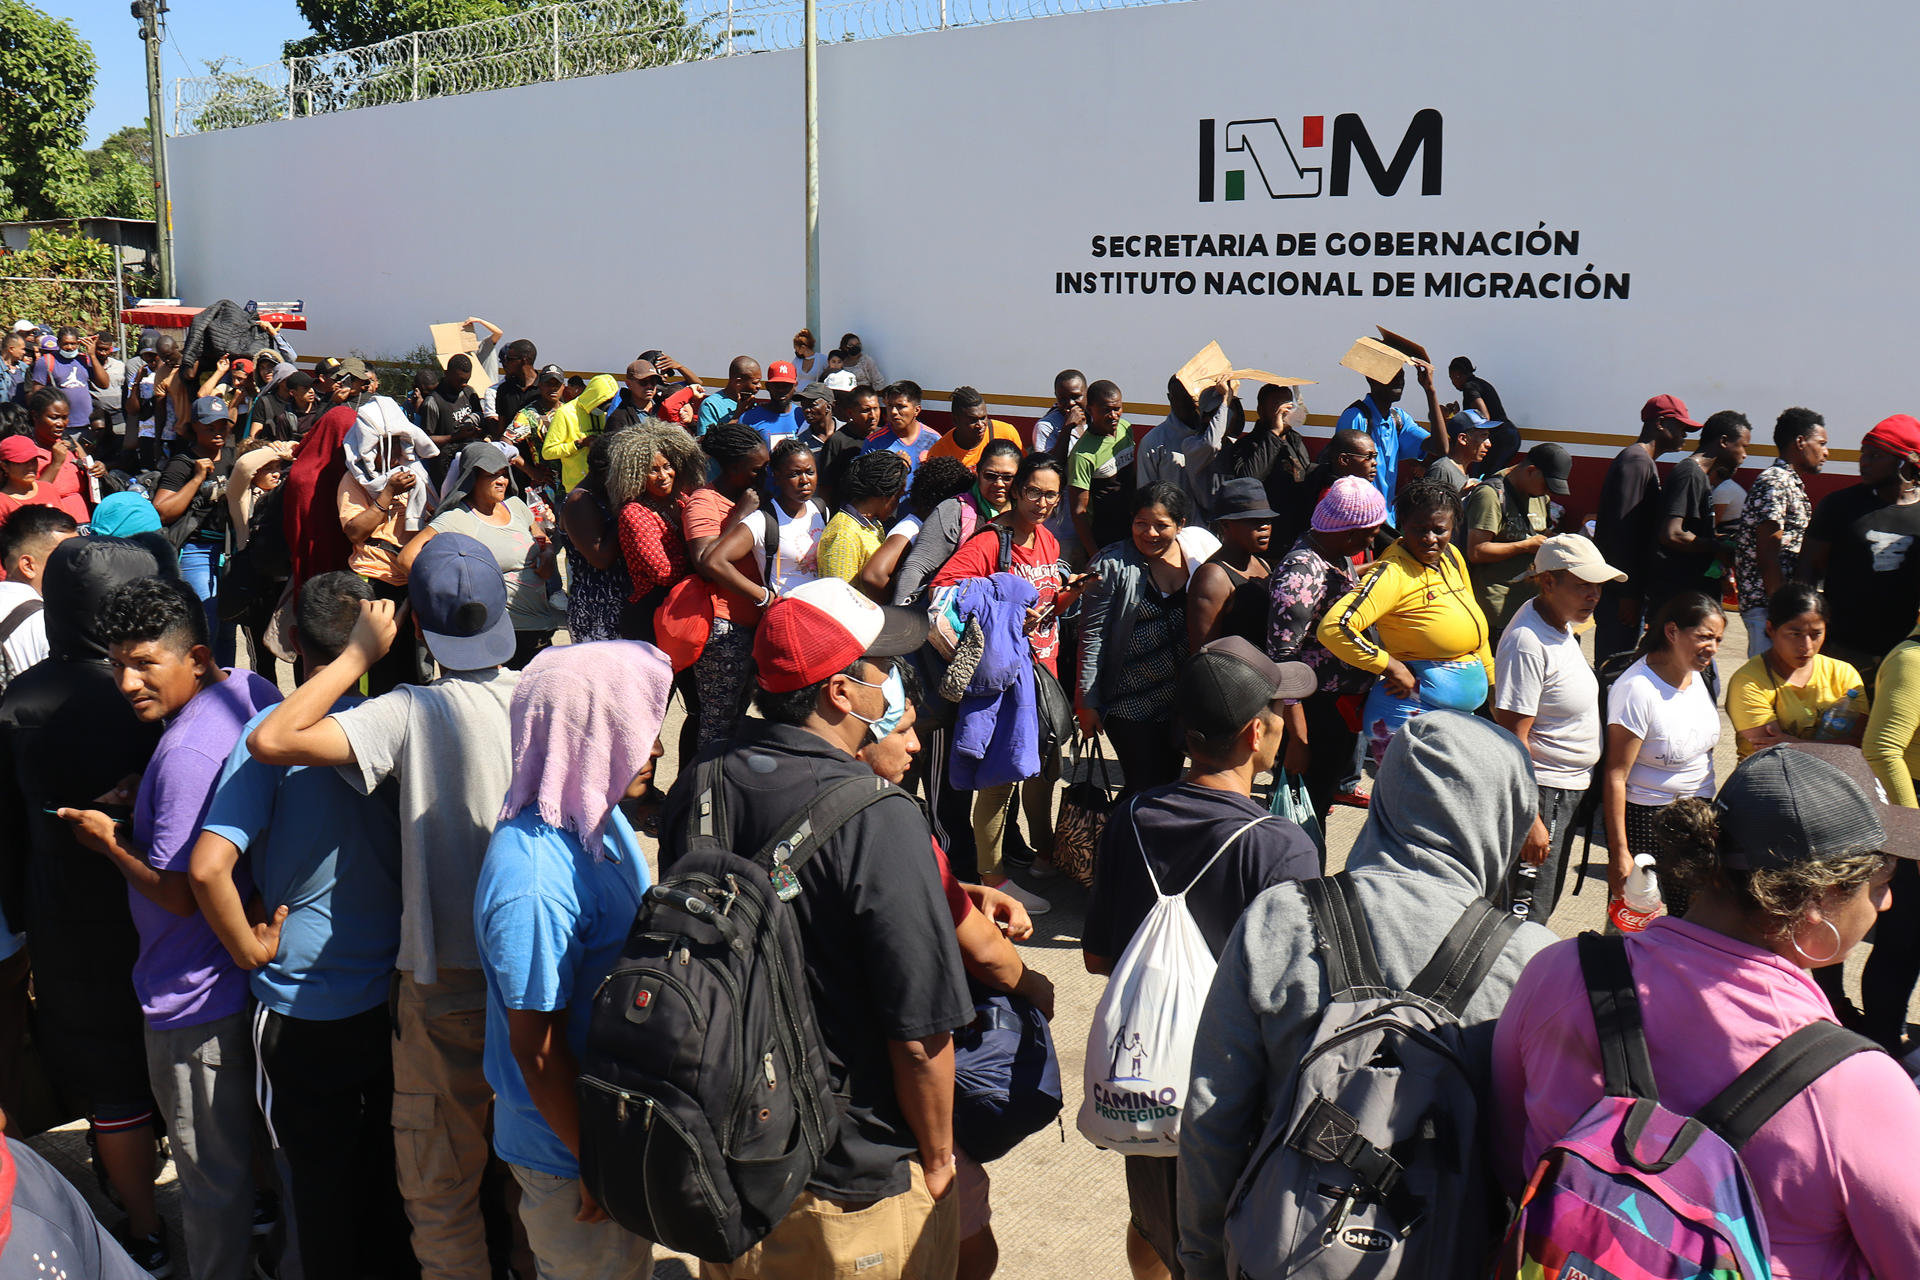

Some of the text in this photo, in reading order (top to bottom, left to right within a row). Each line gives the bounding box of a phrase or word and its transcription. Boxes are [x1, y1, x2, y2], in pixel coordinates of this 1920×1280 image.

[1199, 108, 1443, 202] INM
[1091, 221, 1580, 258] SECRETARIA DE GOBERNACIÓN
[1055, 263, 1631, 300] INSTITUTO NACIONAL DE MIGRACIÓN
[1093, 1083, 1177, 1109] CAMINO
[1095, 1101, 1178, 1123] PROTEGIDO
[1344, 1231, 1390, 1248] bitch
